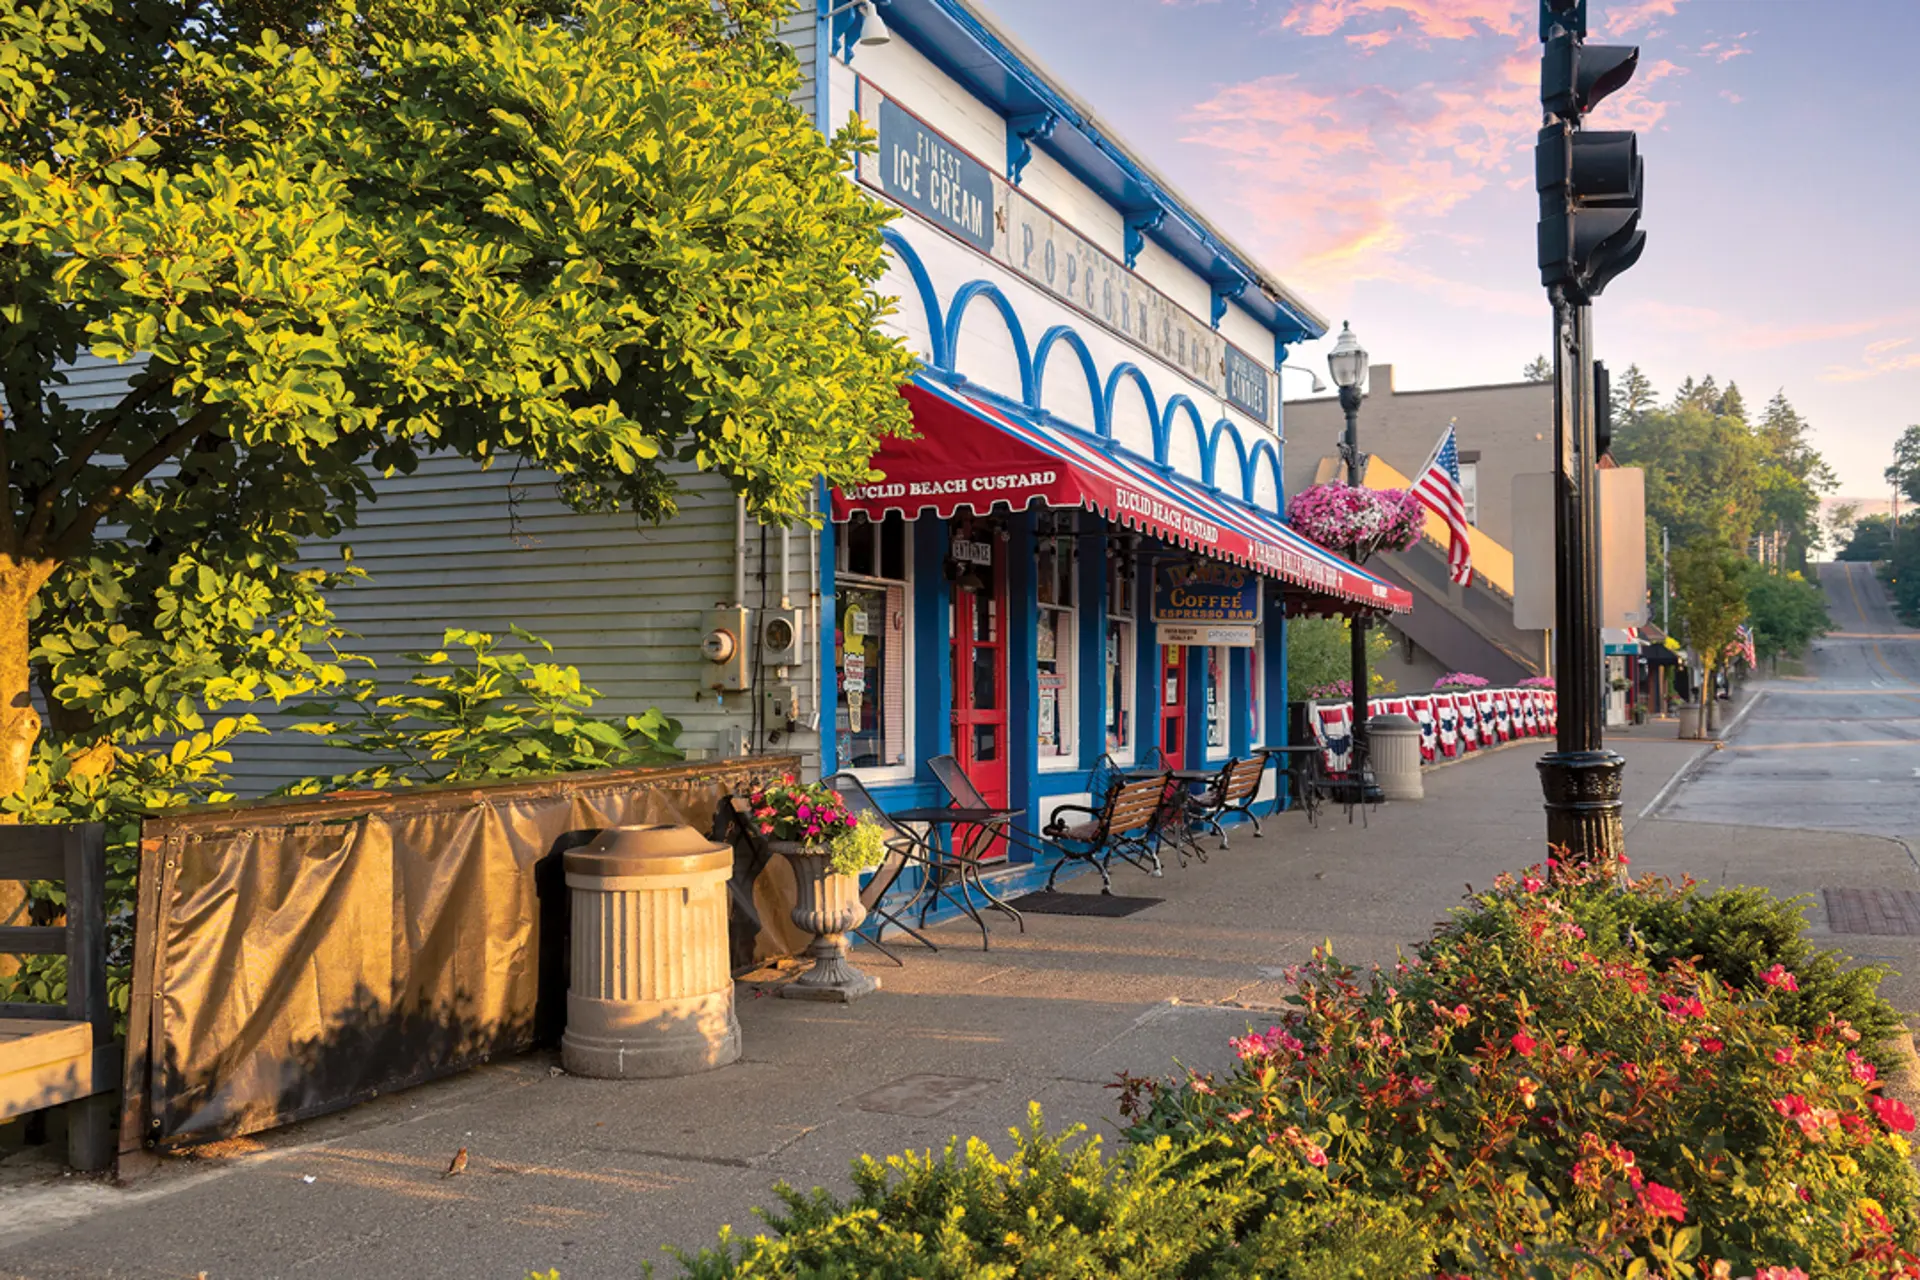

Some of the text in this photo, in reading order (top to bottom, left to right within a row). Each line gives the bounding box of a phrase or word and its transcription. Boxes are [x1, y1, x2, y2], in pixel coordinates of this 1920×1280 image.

[918, 131, 961, 184] FINEST
[893, 144, 983, 238] ICE CREAM
[1022, 222, 1212, 380] POPCORN SHOP
[910, 479, 968, 496] BEACH
[971, 471, 1056, 491] CUSTARD
[1115, 488, 1218, 543] EUCLID BEACH CUSTARD
[1160, 609, 1253, 619] ESPRESSO BAR
